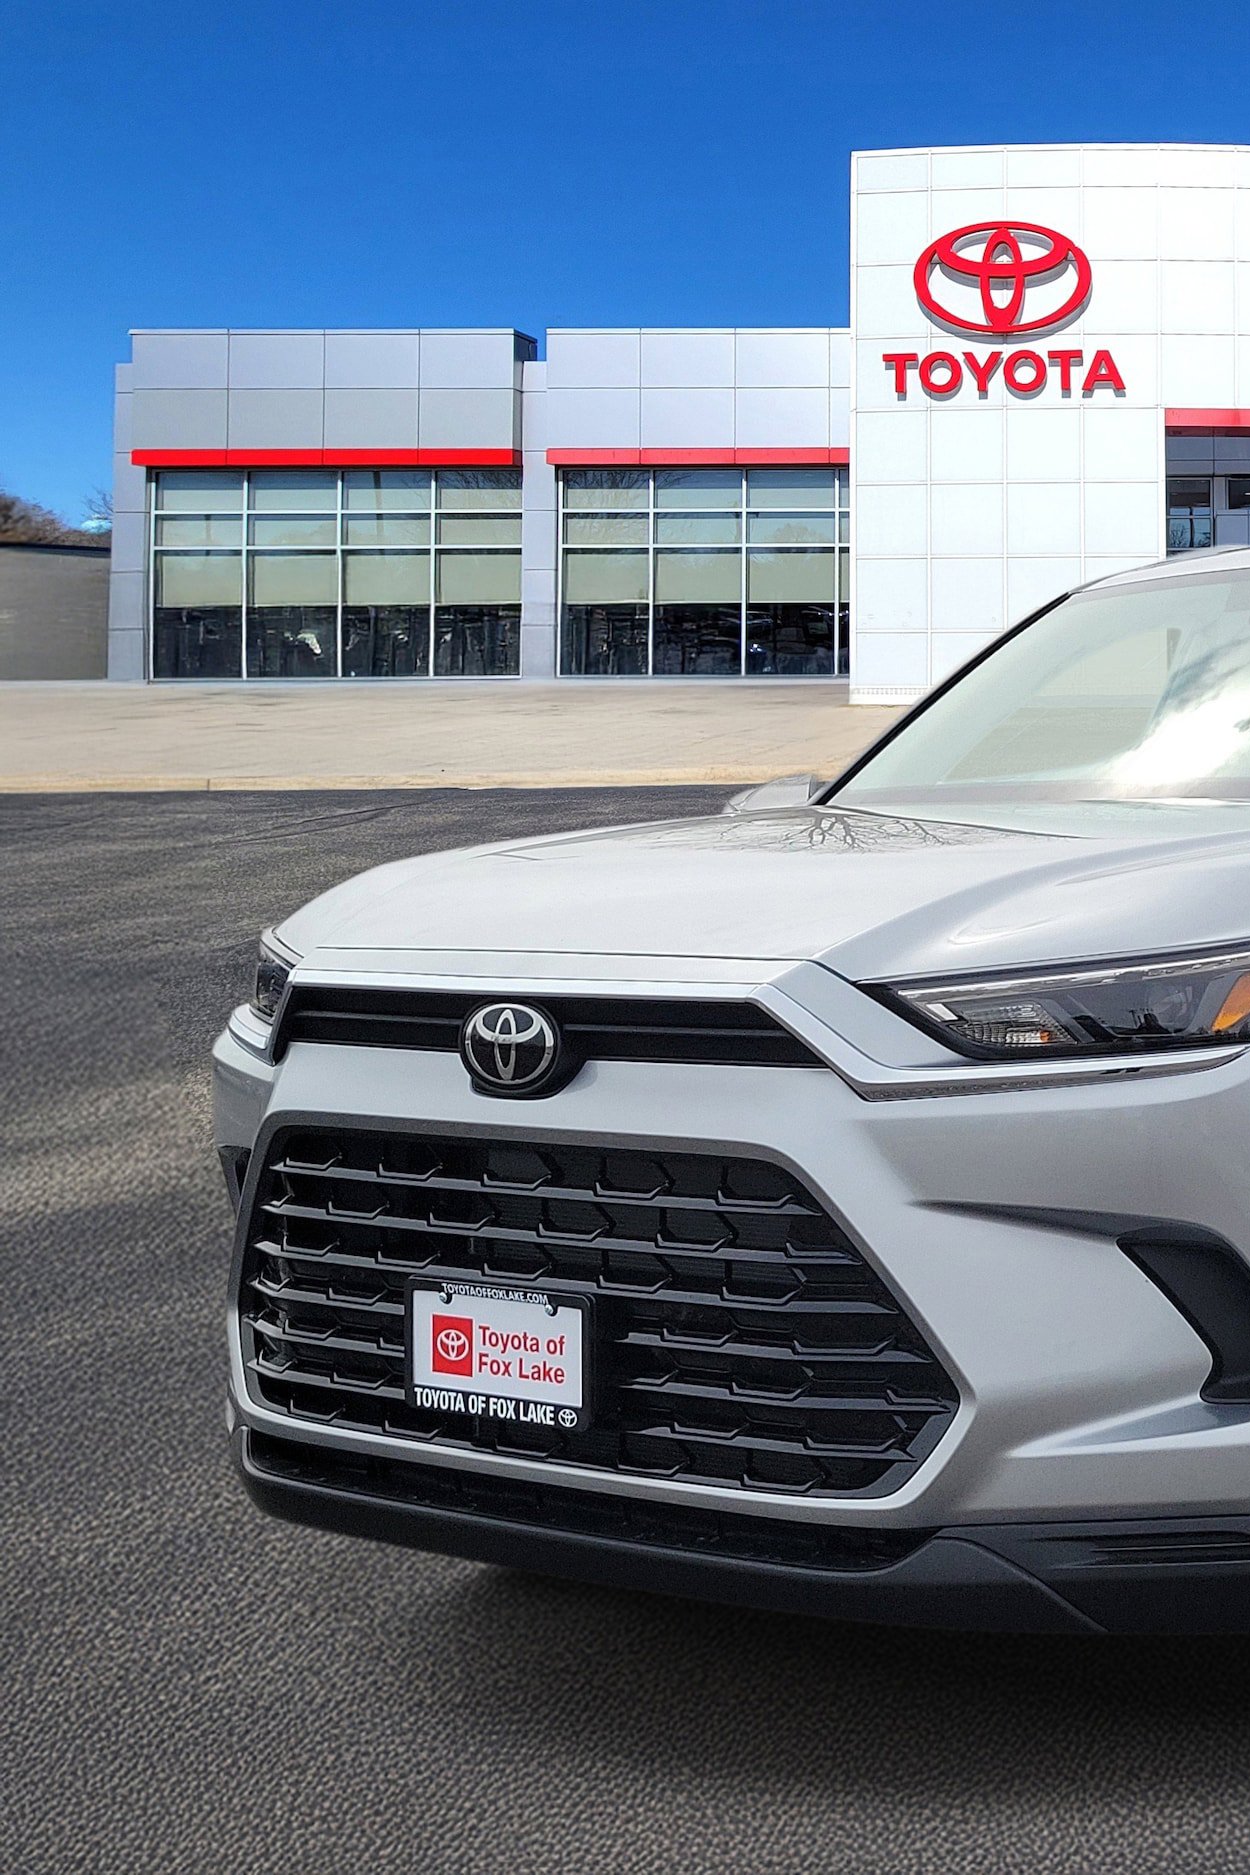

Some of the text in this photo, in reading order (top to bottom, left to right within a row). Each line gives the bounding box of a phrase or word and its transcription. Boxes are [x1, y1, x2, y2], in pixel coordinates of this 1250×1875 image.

[882, 350, 1127, 399] TOYOTA
[441, 1283, 549, 1304] TOYOTAOFFOXLAKE.COM
[478, 1325, 566, 1356] Toyota of
[478, 1352, 565, 1384] Fox Lake
[414, 1386, 555, 1426] TOYOTA OF FOX LAKE
